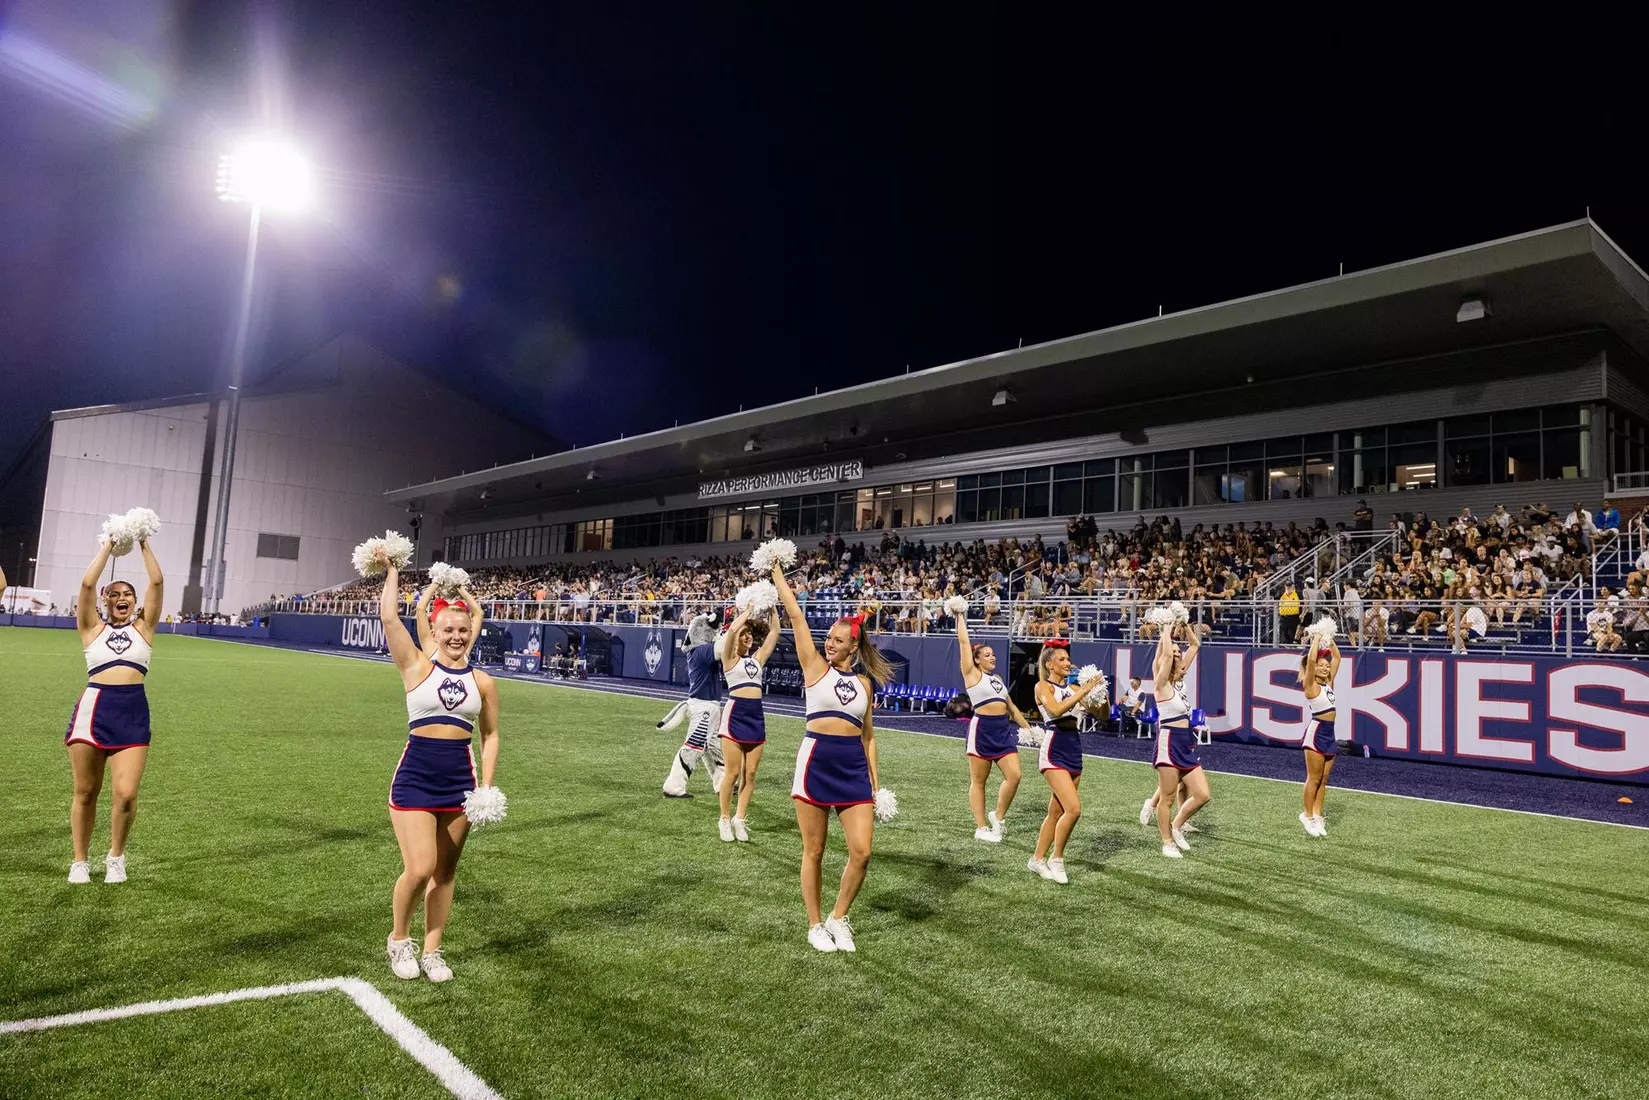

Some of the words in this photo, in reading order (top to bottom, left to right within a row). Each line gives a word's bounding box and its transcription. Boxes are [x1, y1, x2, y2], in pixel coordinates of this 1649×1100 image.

[700, 481, 727, 497] RIZZA
[729, 469, 809, 493] PERFORMANCE
[811, 461, 862, 481] CENTER
[342, 618, 385, 647] UCONN
[505, 657, 521, 667] UCONN
